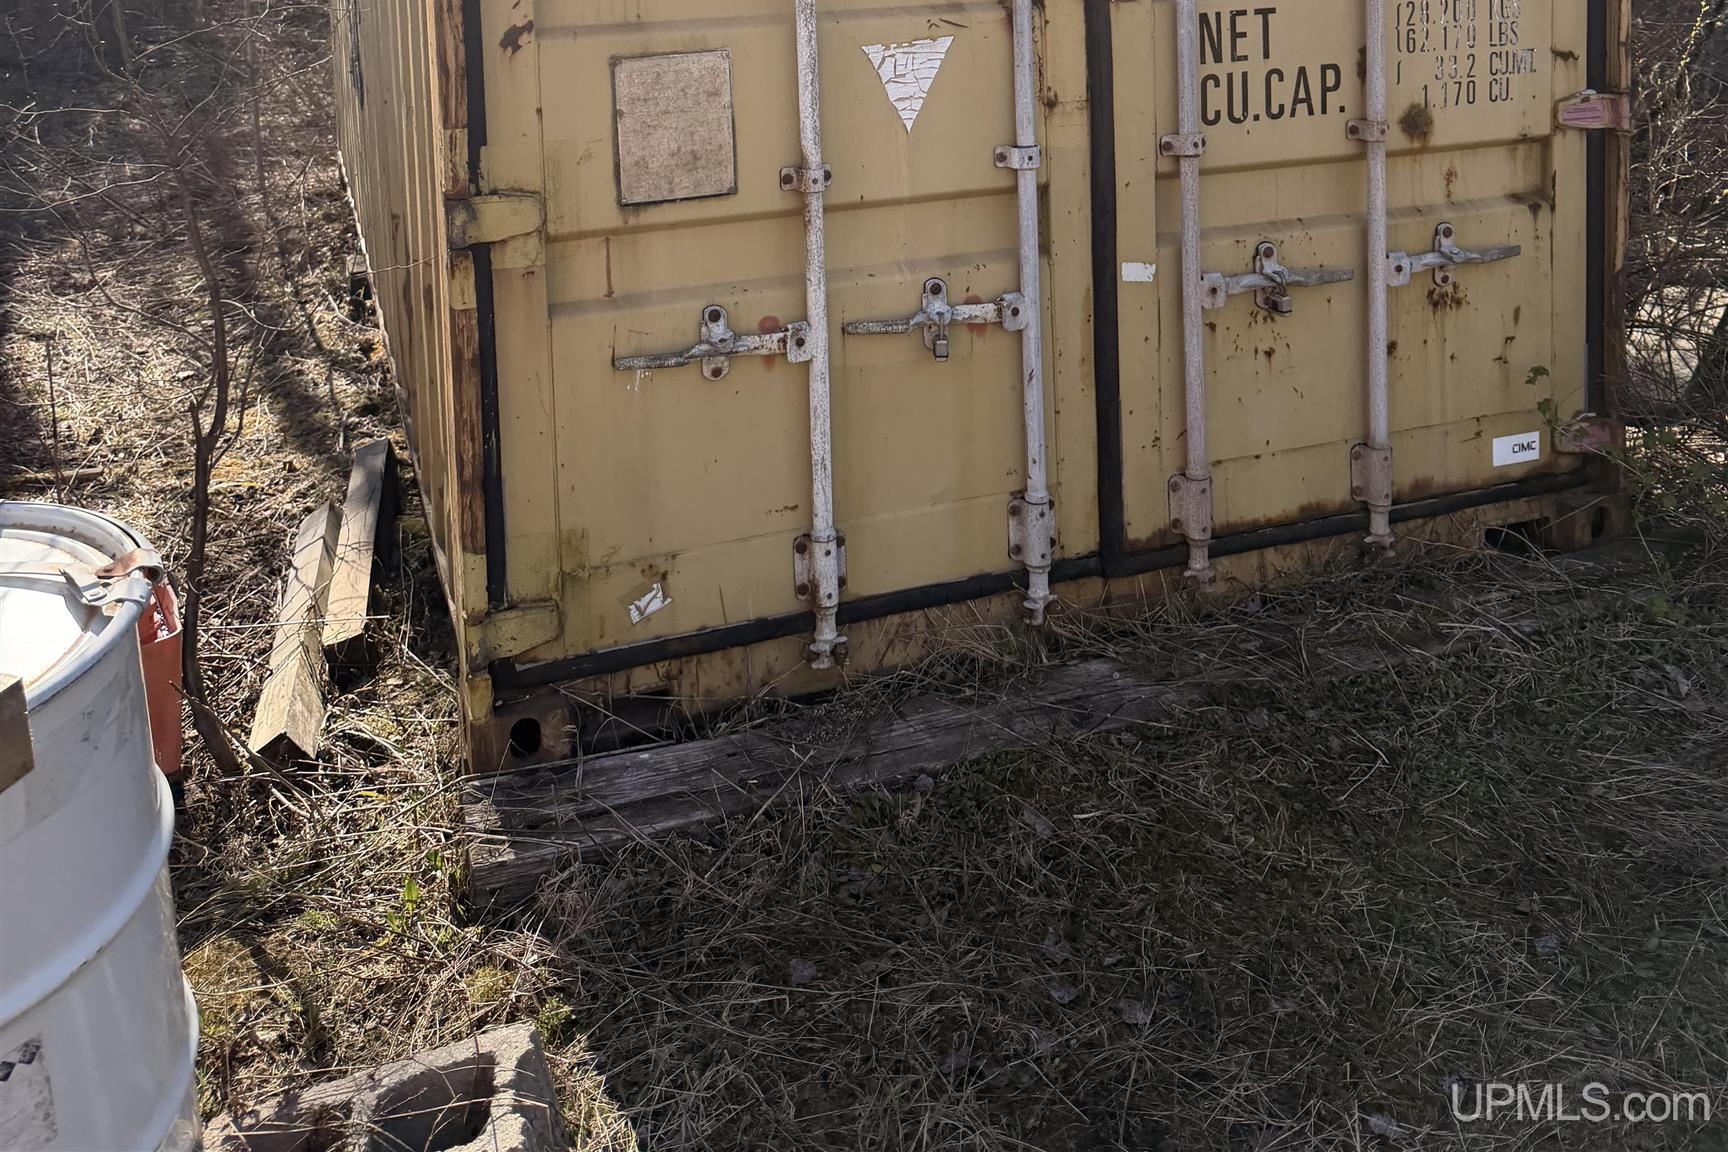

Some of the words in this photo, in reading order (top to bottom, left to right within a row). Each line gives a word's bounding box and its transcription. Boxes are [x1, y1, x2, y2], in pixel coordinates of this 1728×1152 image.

[1199, 7, 1276, 65] NET
[1488, 21, 1519, 47] LBS
[1512, 440, 1536, 453] CIMC
